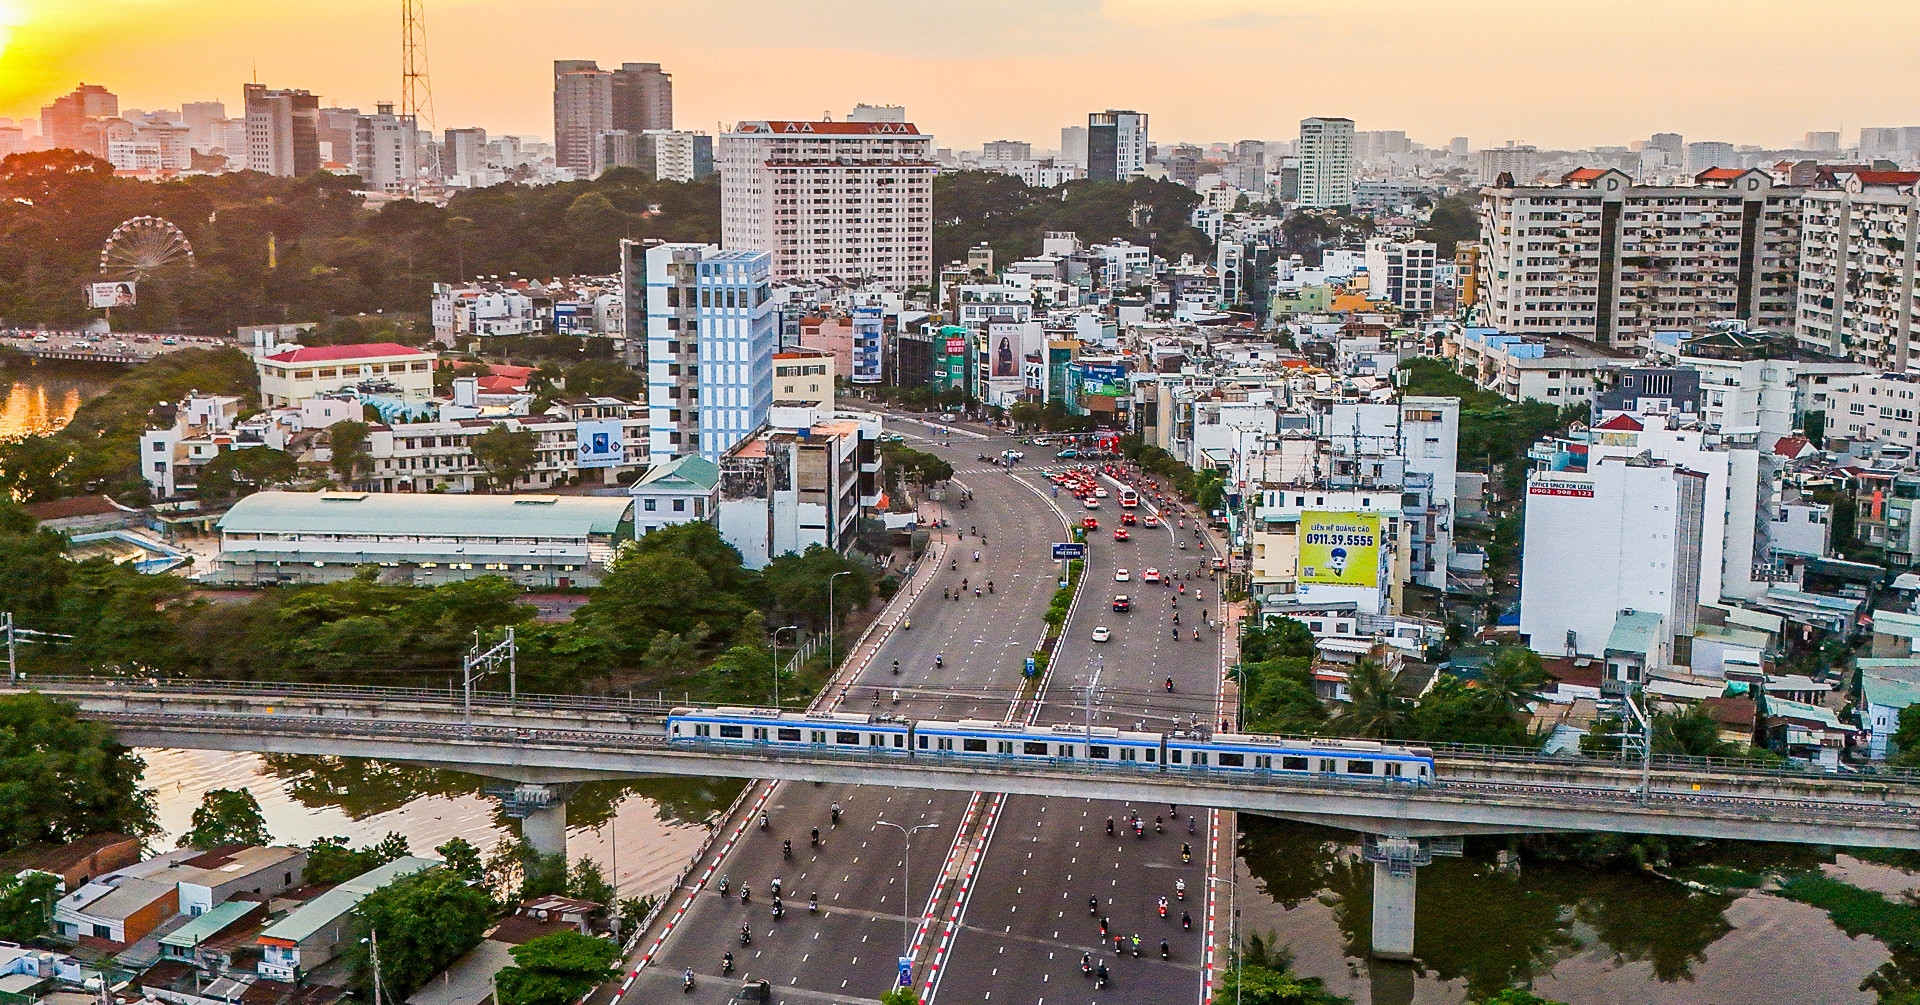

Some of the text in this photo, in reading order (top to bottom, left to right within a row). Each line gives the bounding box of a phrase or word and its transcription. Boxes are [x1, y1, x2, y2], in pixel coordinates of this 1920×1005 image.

[1607, 178, 1619, 191] D
[1747, 178, 1760, 191] D
[1851, 180, 1857, 193] C
[1307, 534, 1373, 545] 0911.39.5555
